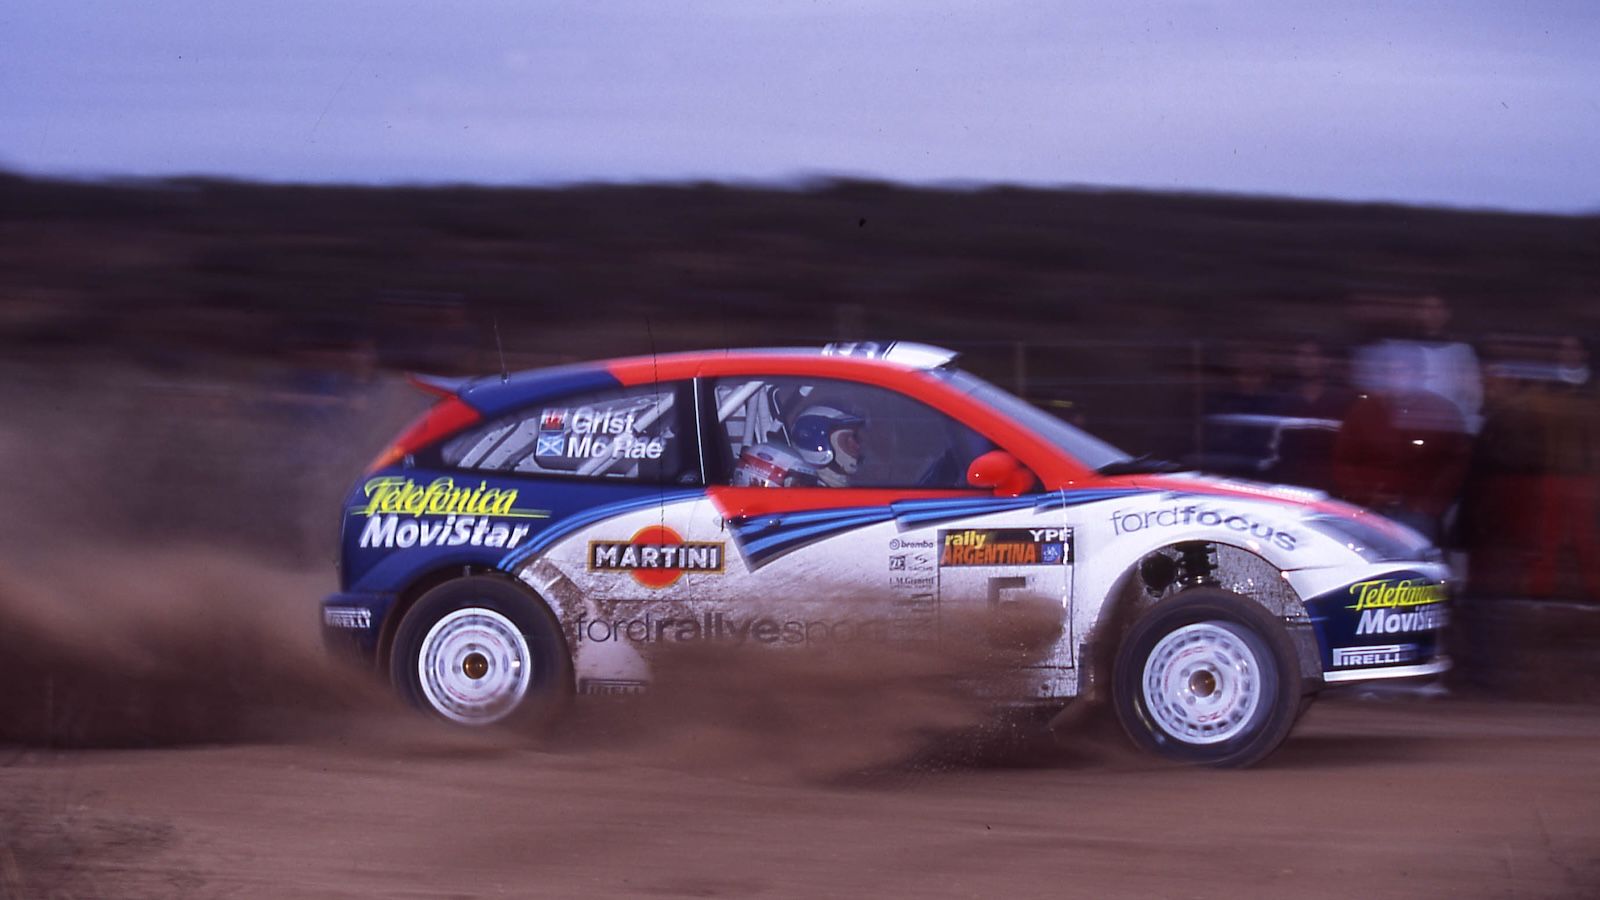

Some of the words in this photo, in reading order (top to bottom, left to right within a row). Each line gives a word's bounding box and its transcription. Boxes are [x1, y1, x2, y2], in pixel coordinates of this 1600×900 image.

[571, 407, 635, 434] Grist
[567, 435, 607, 458] Mc
[612, 435, 663, 458] Rae
[359, 515, 530, 549] MoviStar
[945, 531, 986, 549] rally
[1030, 529, 1072, 542] YPF
[595, 547, 717, 569] MARTINI
[941, 544, 1037, 565] ARGENTINA
[1333, 645, 1400, 666] PIRELLI
